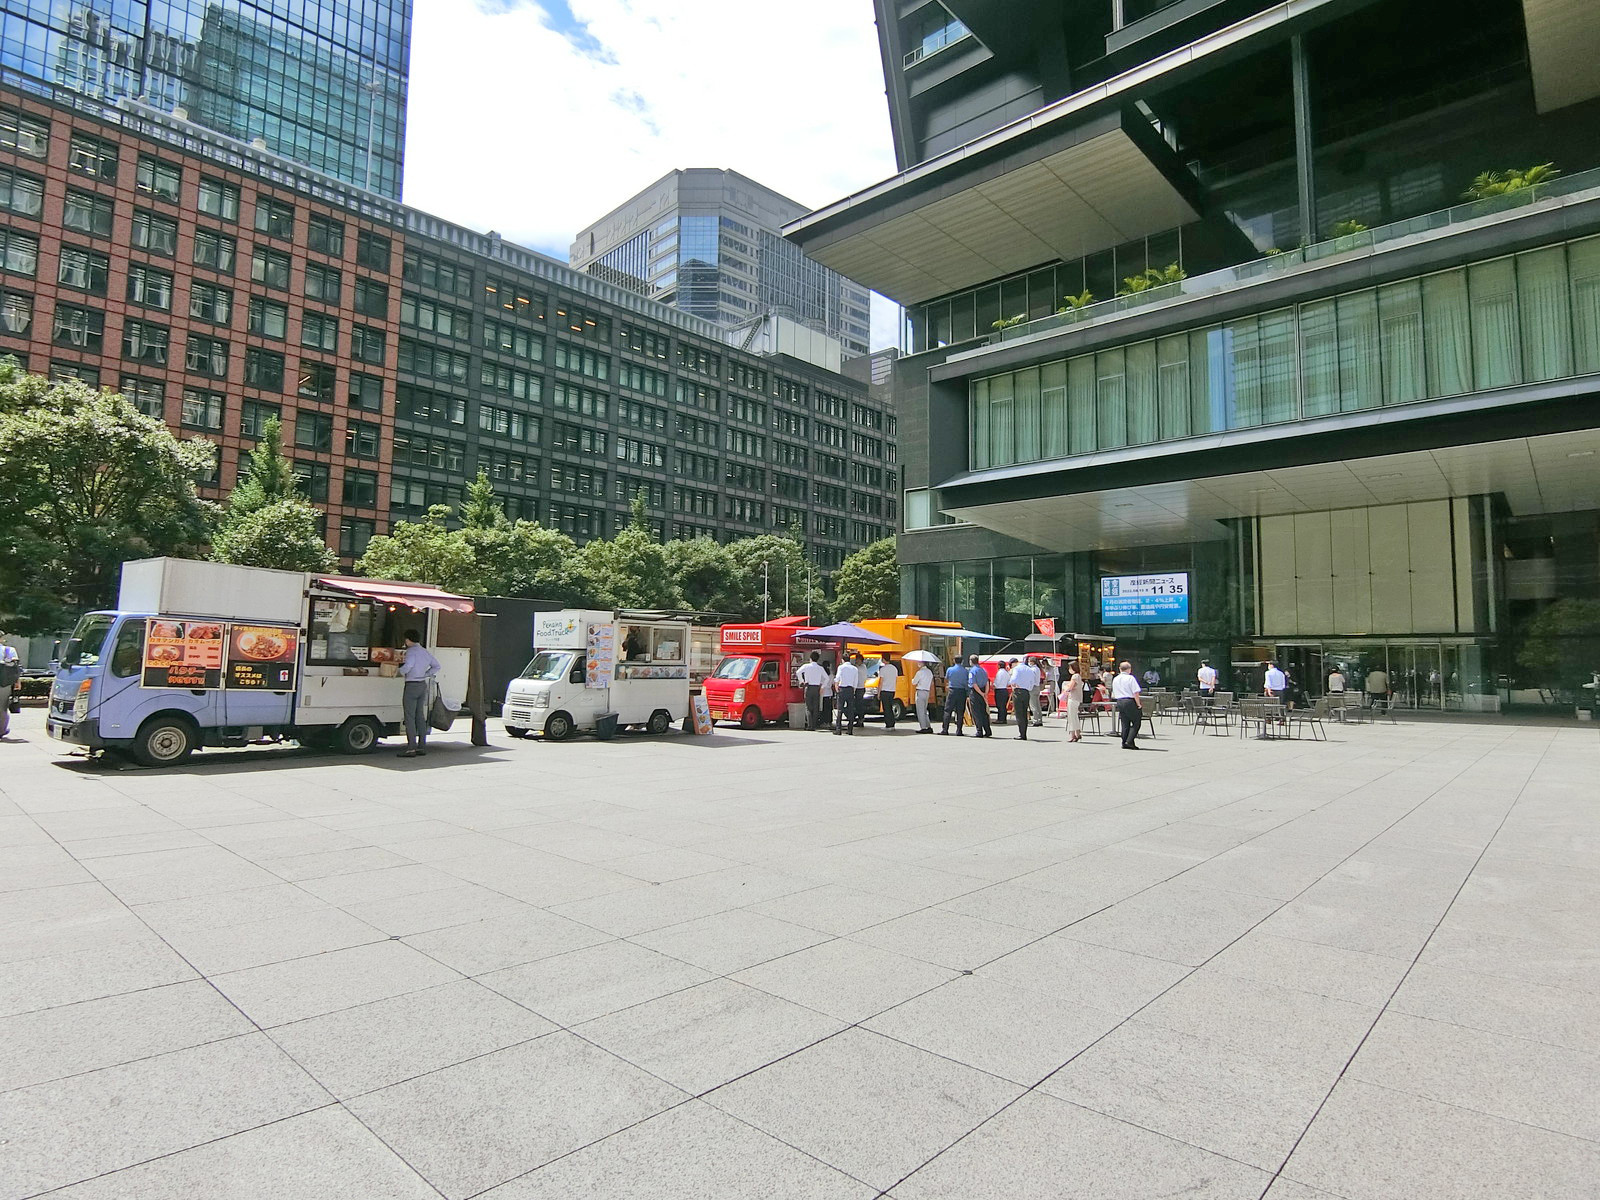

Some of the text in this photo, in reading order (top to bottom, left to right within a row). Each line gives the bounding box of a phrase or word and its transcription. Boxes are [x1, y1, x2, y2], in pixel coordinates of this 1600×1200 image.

[1151, 585, 1164, 594] 11
[1169, 584, 1183, 594] 35
[725, 631, 760, 641] SMILE SPICE
[169, 666, 206, 675] パクチー
